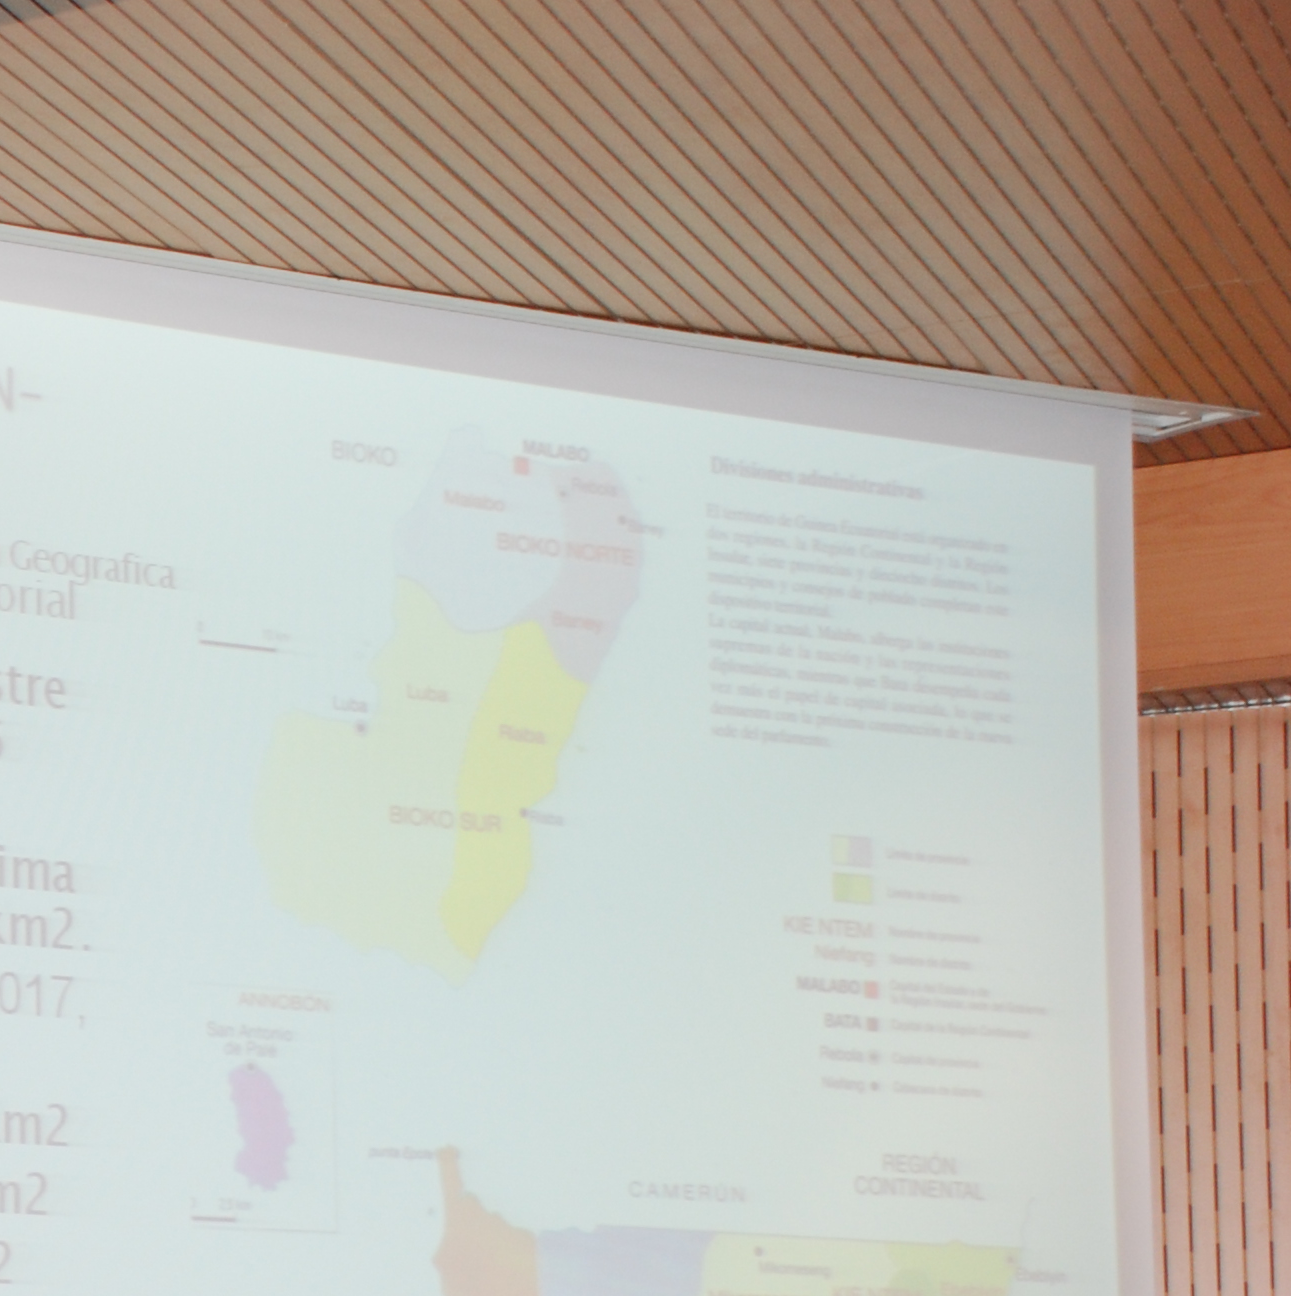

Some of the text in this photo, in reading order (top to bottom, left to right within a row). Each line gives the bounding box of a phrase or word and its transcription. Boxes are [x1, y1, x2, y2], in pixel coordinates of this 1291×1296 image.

[331, 439, 397, 467] BIOKO
[523, 439, 590, 462] MALABO
[496, 531, 636, 567] BIOKO NORTE
[9, 539, 177, 589] Geografica
[389, 805, 455, 829] BIOKO
[461, 809, 503, 834] SUR
[854, 1176, 986, 1201] CONTINENTAL
